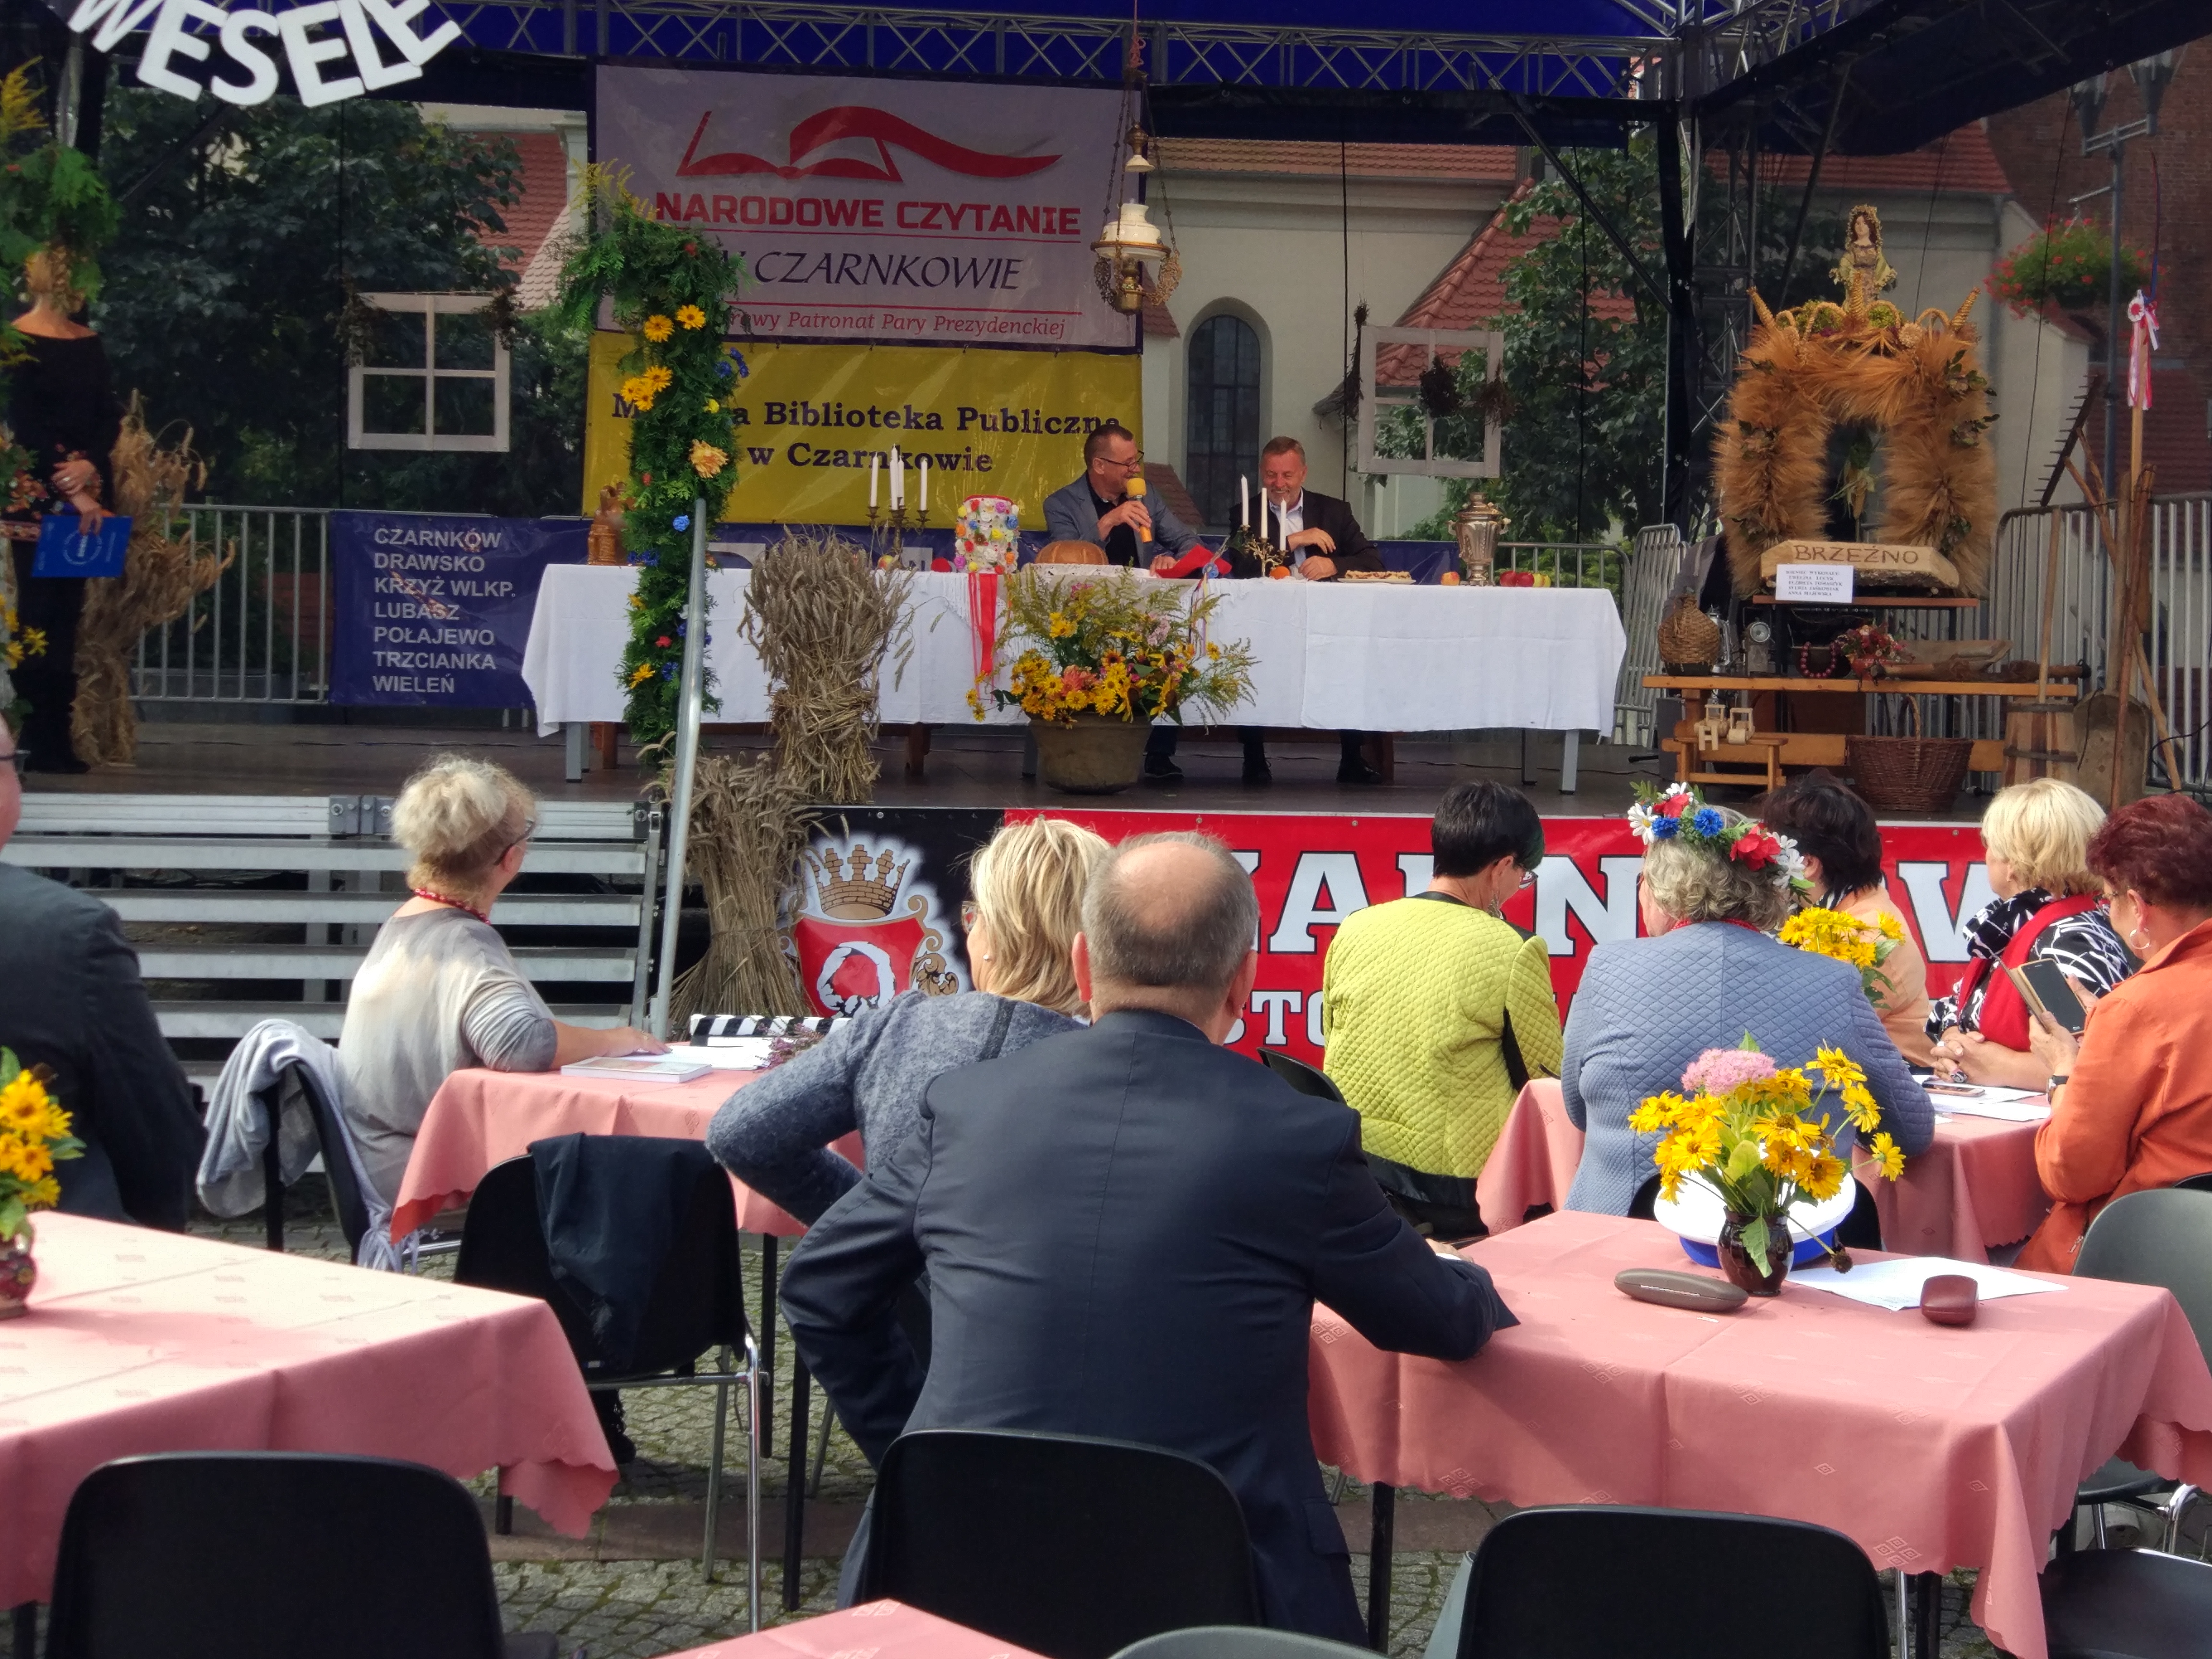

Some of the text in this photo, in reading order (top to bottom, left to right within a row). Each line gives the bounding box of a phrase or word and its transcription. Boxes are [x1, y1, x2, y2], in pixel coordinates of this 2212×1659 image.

[656, 192, 1081, 235] NARODOWE CZYTANIE
[755, 251, 1023, 289] CZARNKOWIE
[787, 312, 875, 329] Patronat
[881, 314, 927, 335] Pary
[933, 315, 1066, 339] Prezydenckiej
[764, 401, 944, 431] Biblioteka
[747, 447, 775, 465] w
[374, 528, 501, 548] CZARNKÓW
[374, 553, 485, 572] DRAWSKO
[374, 576, 516, 597] KRZYŻ WLKP.
[374, 602, 460, 620] LUBASZ
[374, 626, 495, 645] POŁAJEWO
[373, 651, 496, 670] TRZCIANKA
[373, 673, 455, 693] WIELEŃ
